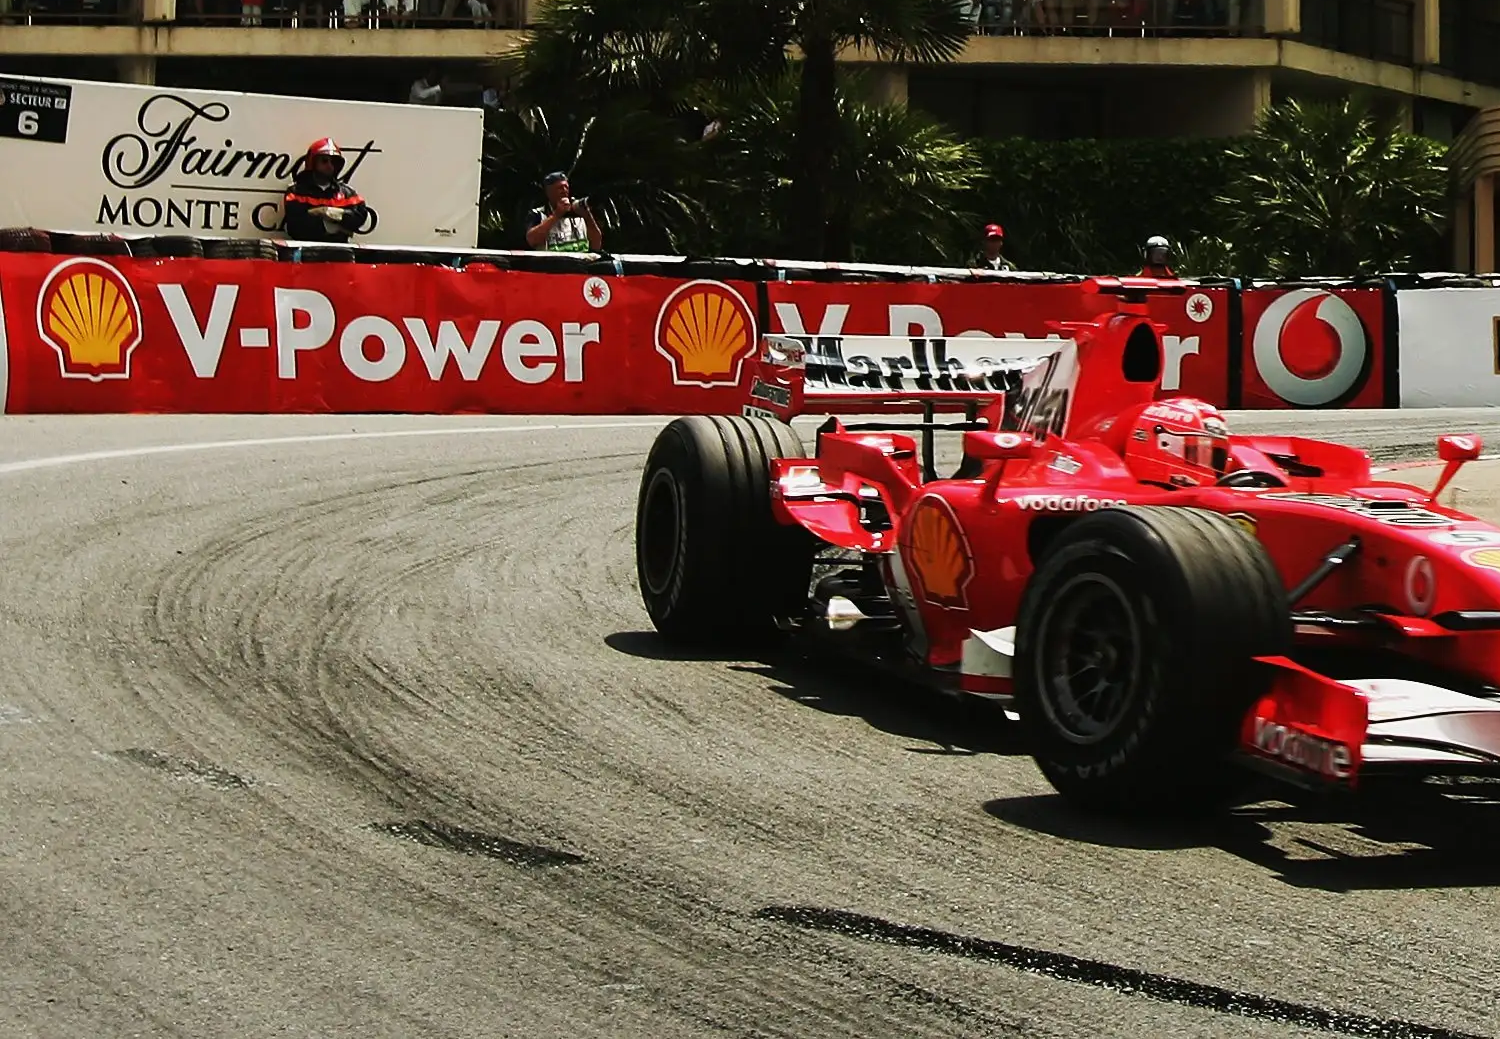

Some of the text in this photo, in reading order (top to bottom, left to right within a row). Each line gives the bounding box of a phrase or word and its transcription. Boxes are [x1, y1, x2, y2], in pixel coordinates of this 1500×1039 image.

[10, 92, 52, 109] SECTEUR
[18, 110, 39, 136] 6
[101, 94, 383, 190] Fairmt
[96, 194, 240, 230] MONTE
[157, 283, 601, 383] V-Power
